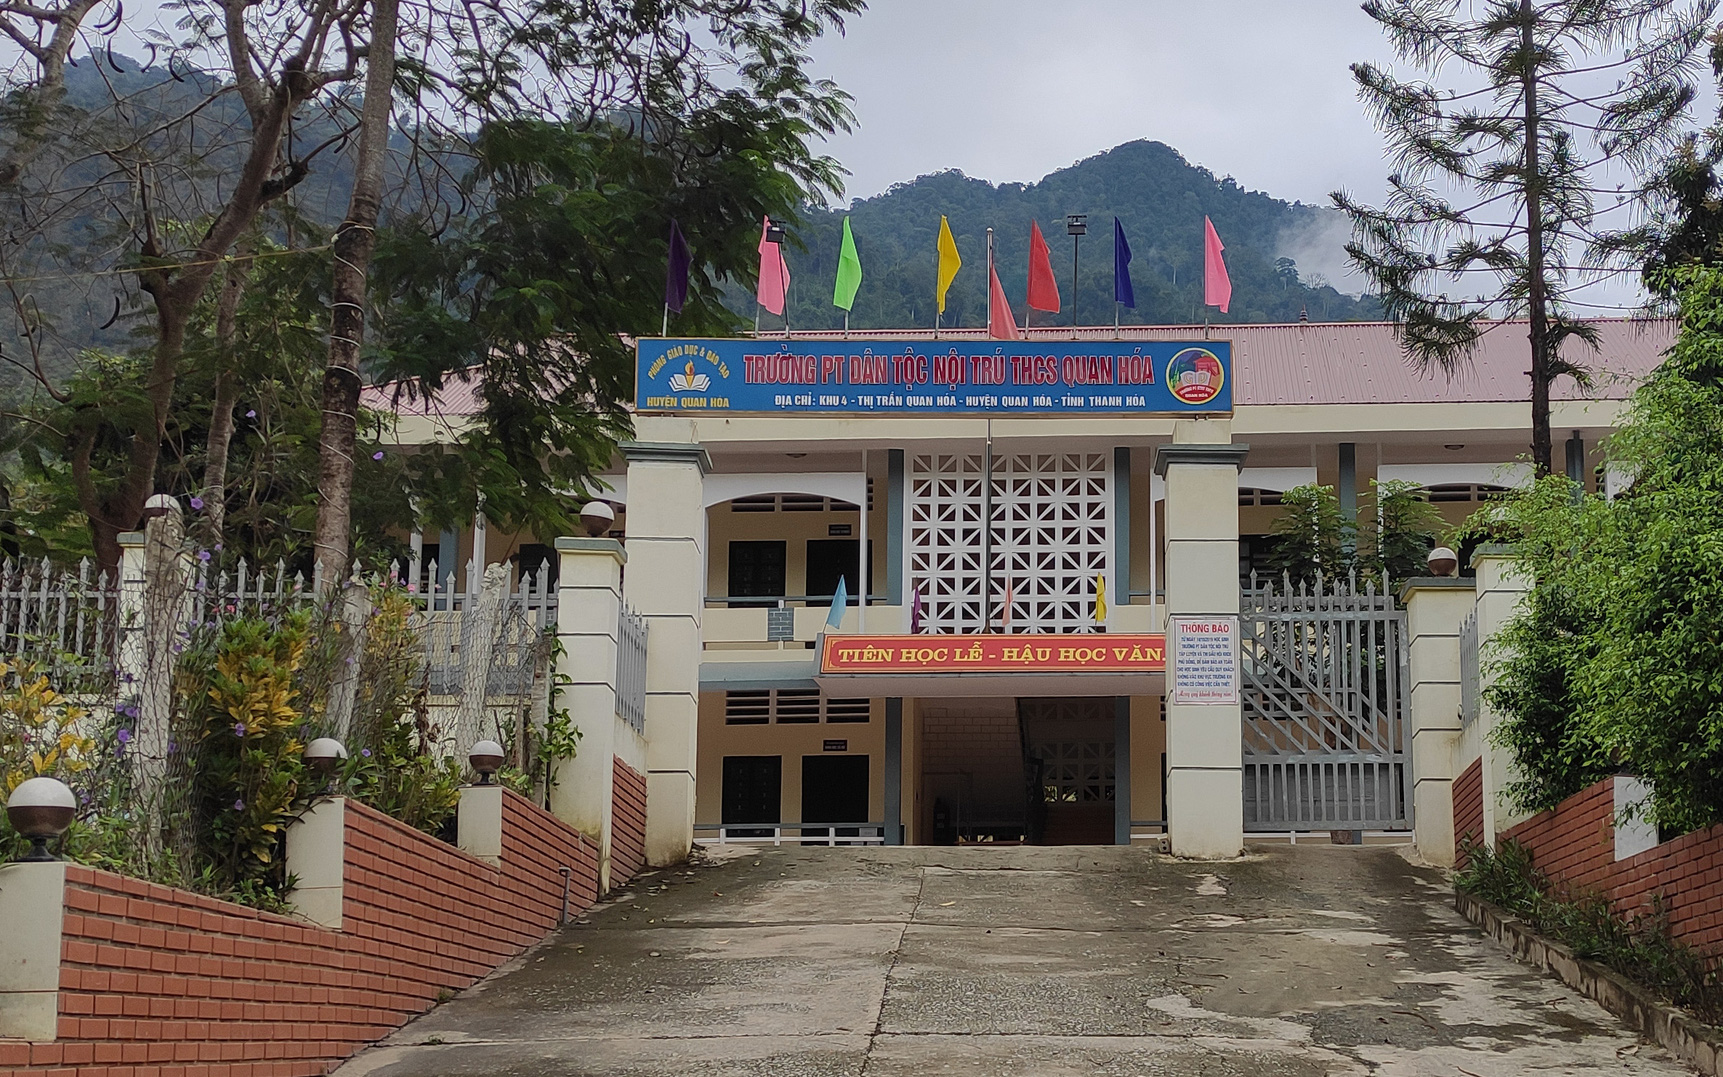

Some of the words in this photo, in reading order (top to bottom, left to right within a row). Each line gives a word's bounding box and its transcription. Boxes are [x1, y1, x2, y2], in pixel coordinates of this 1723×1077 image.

[684, 345, 698, 358] DỤC
[699, 347, 705, 356] &
[718, 361, 730, 379] TẠO
[743, 344, 816, 384] TRƯỜNG
[821, 355, 846, 384] PT
[849, 348, 889, 384] DÂN
[892, 348, 928, 390] TỘC
[933, 348, 966, 390] NỘI
[970, 348, 1005, 384] TRÚ
[1010, 356, 1058, 384] THCS
[1062, 356, 1112, 387] QUAN
[1118, 348, 1154, 384] HÓA
[647, 395, 677, 408] HUYỆN
[681, 398, 706, 408] QUAN
[774, 395, 792, 409] ĐỊA
[794, 392, 816, 406] CHỈ:
[819, 395, 839, 406] KHU
[840, 395, 848, 406] 4
[858, 396, 873, 410] THỊ
[876, 392, 902, 406] TRẤN
[906, 396, 932, 408] QUAN
[936, 393, 957, 406] HÓA
[966, 394, 998, 410] HUYỆN
[1002, 396, 1028, 408] QUAN
[1033, 393, 1052, 406] HÓA
[1061, 392, 1084, 406] TỈNH
[1089, 396, 1122, 407] THANH
[1126, 393, 1146, 406] HÓA
[1180, 622, 1209, 633] THÔNG
[899, 648, 948, 666] HỌC
[953, 641, 983, 662] LỄ
[1002, 644, 1050, 665] HẬU
[1057, 648, 1106, 665] HỌC
